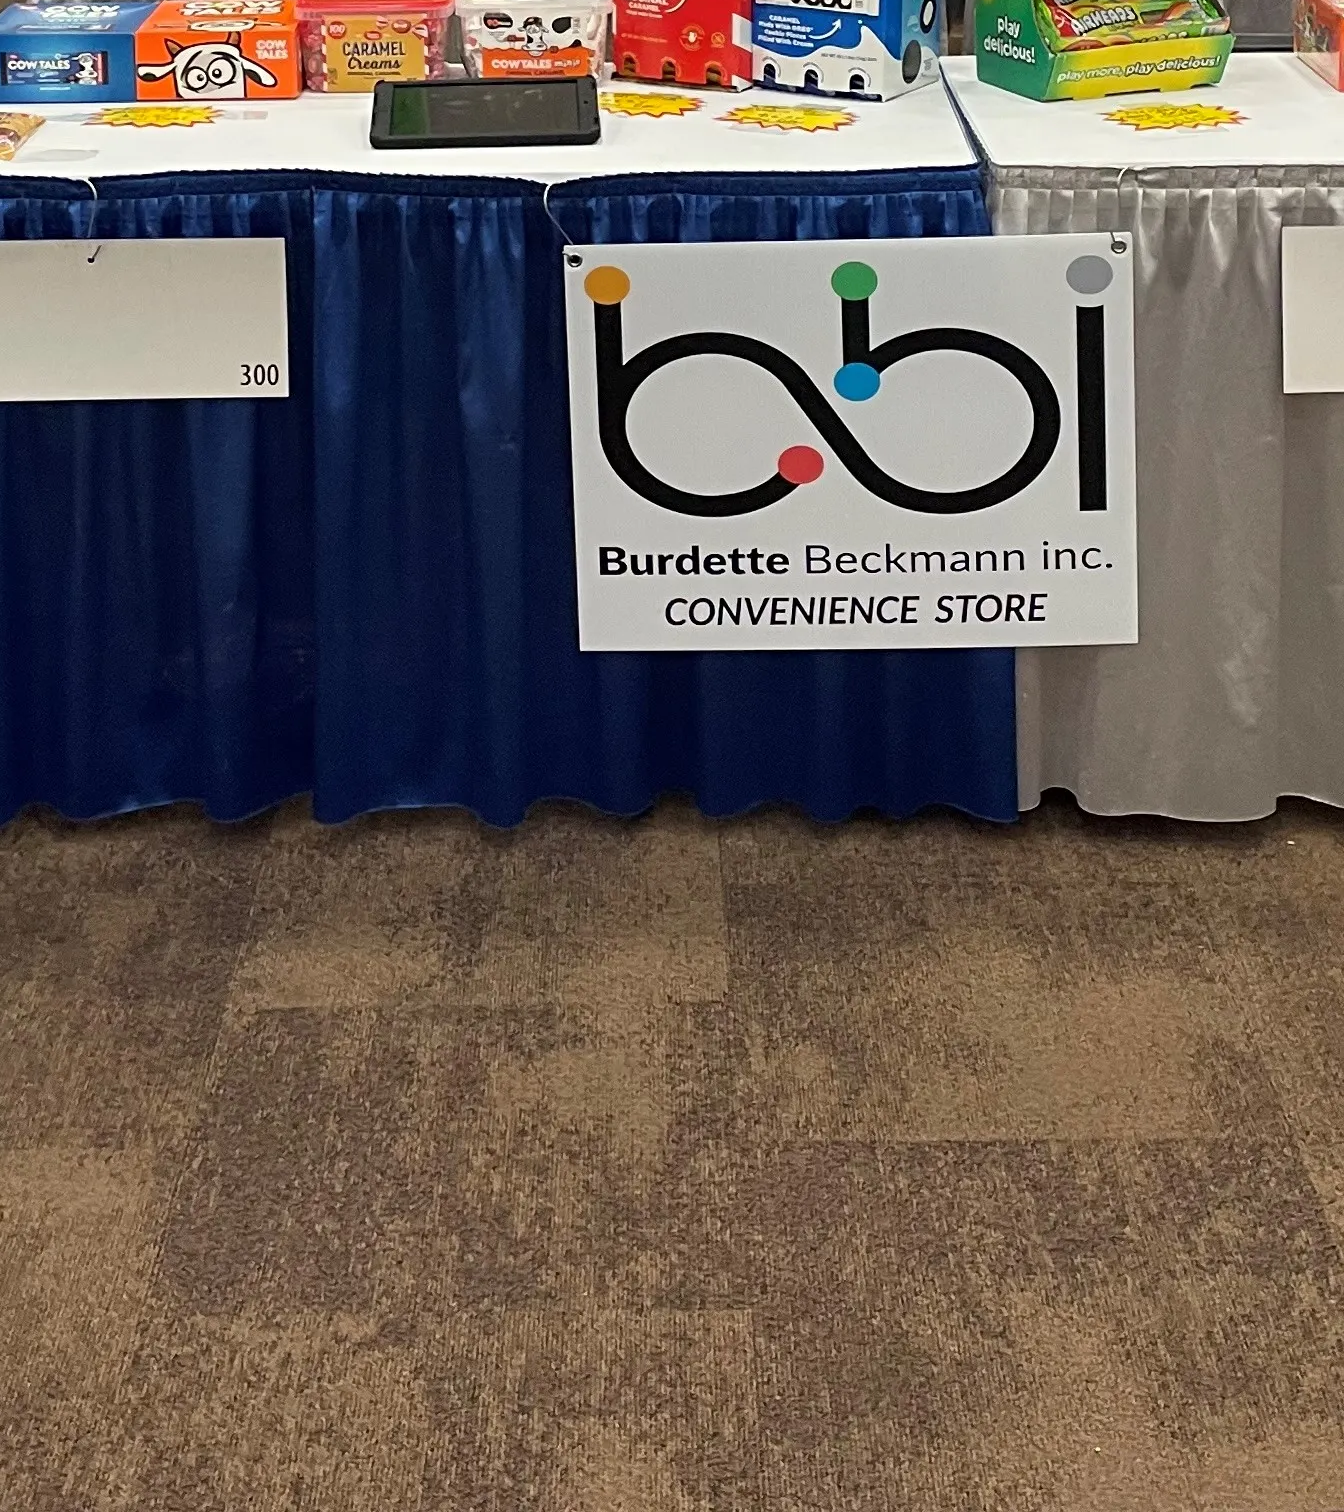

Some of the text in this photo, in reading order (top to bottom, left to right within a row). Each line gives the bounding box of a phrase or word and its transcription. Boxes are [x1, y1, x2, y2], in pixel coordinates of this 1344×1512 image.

[179, 8, 285, 16] TALES
[185, 0, 285, 10] COW
[628, 1, 661, 13] CARAMEL
[768, 15, 801, 25] CARAMEL
[1070, 5, 1138, 36] AIRHEADS
[996, 16, 1021, 40] play
[255, 39, 287, 51] COW
[343, 41, 406, 56] CARAMEL
[983, 34, 1036, 65] delicious!
[255, 48, 289, 60] TALES
[7, 59, 71, 70] COW TALES
[347, 56, 402, 70] Creams
[1056, 55, 1221, 84] play more, play delicious!
[240, 363, 279, 386] 300
[598, 540, 1114, 576] Burdette Beckmann inc.
[664, 593, 1048, 626] CONVENIENCE STORE
